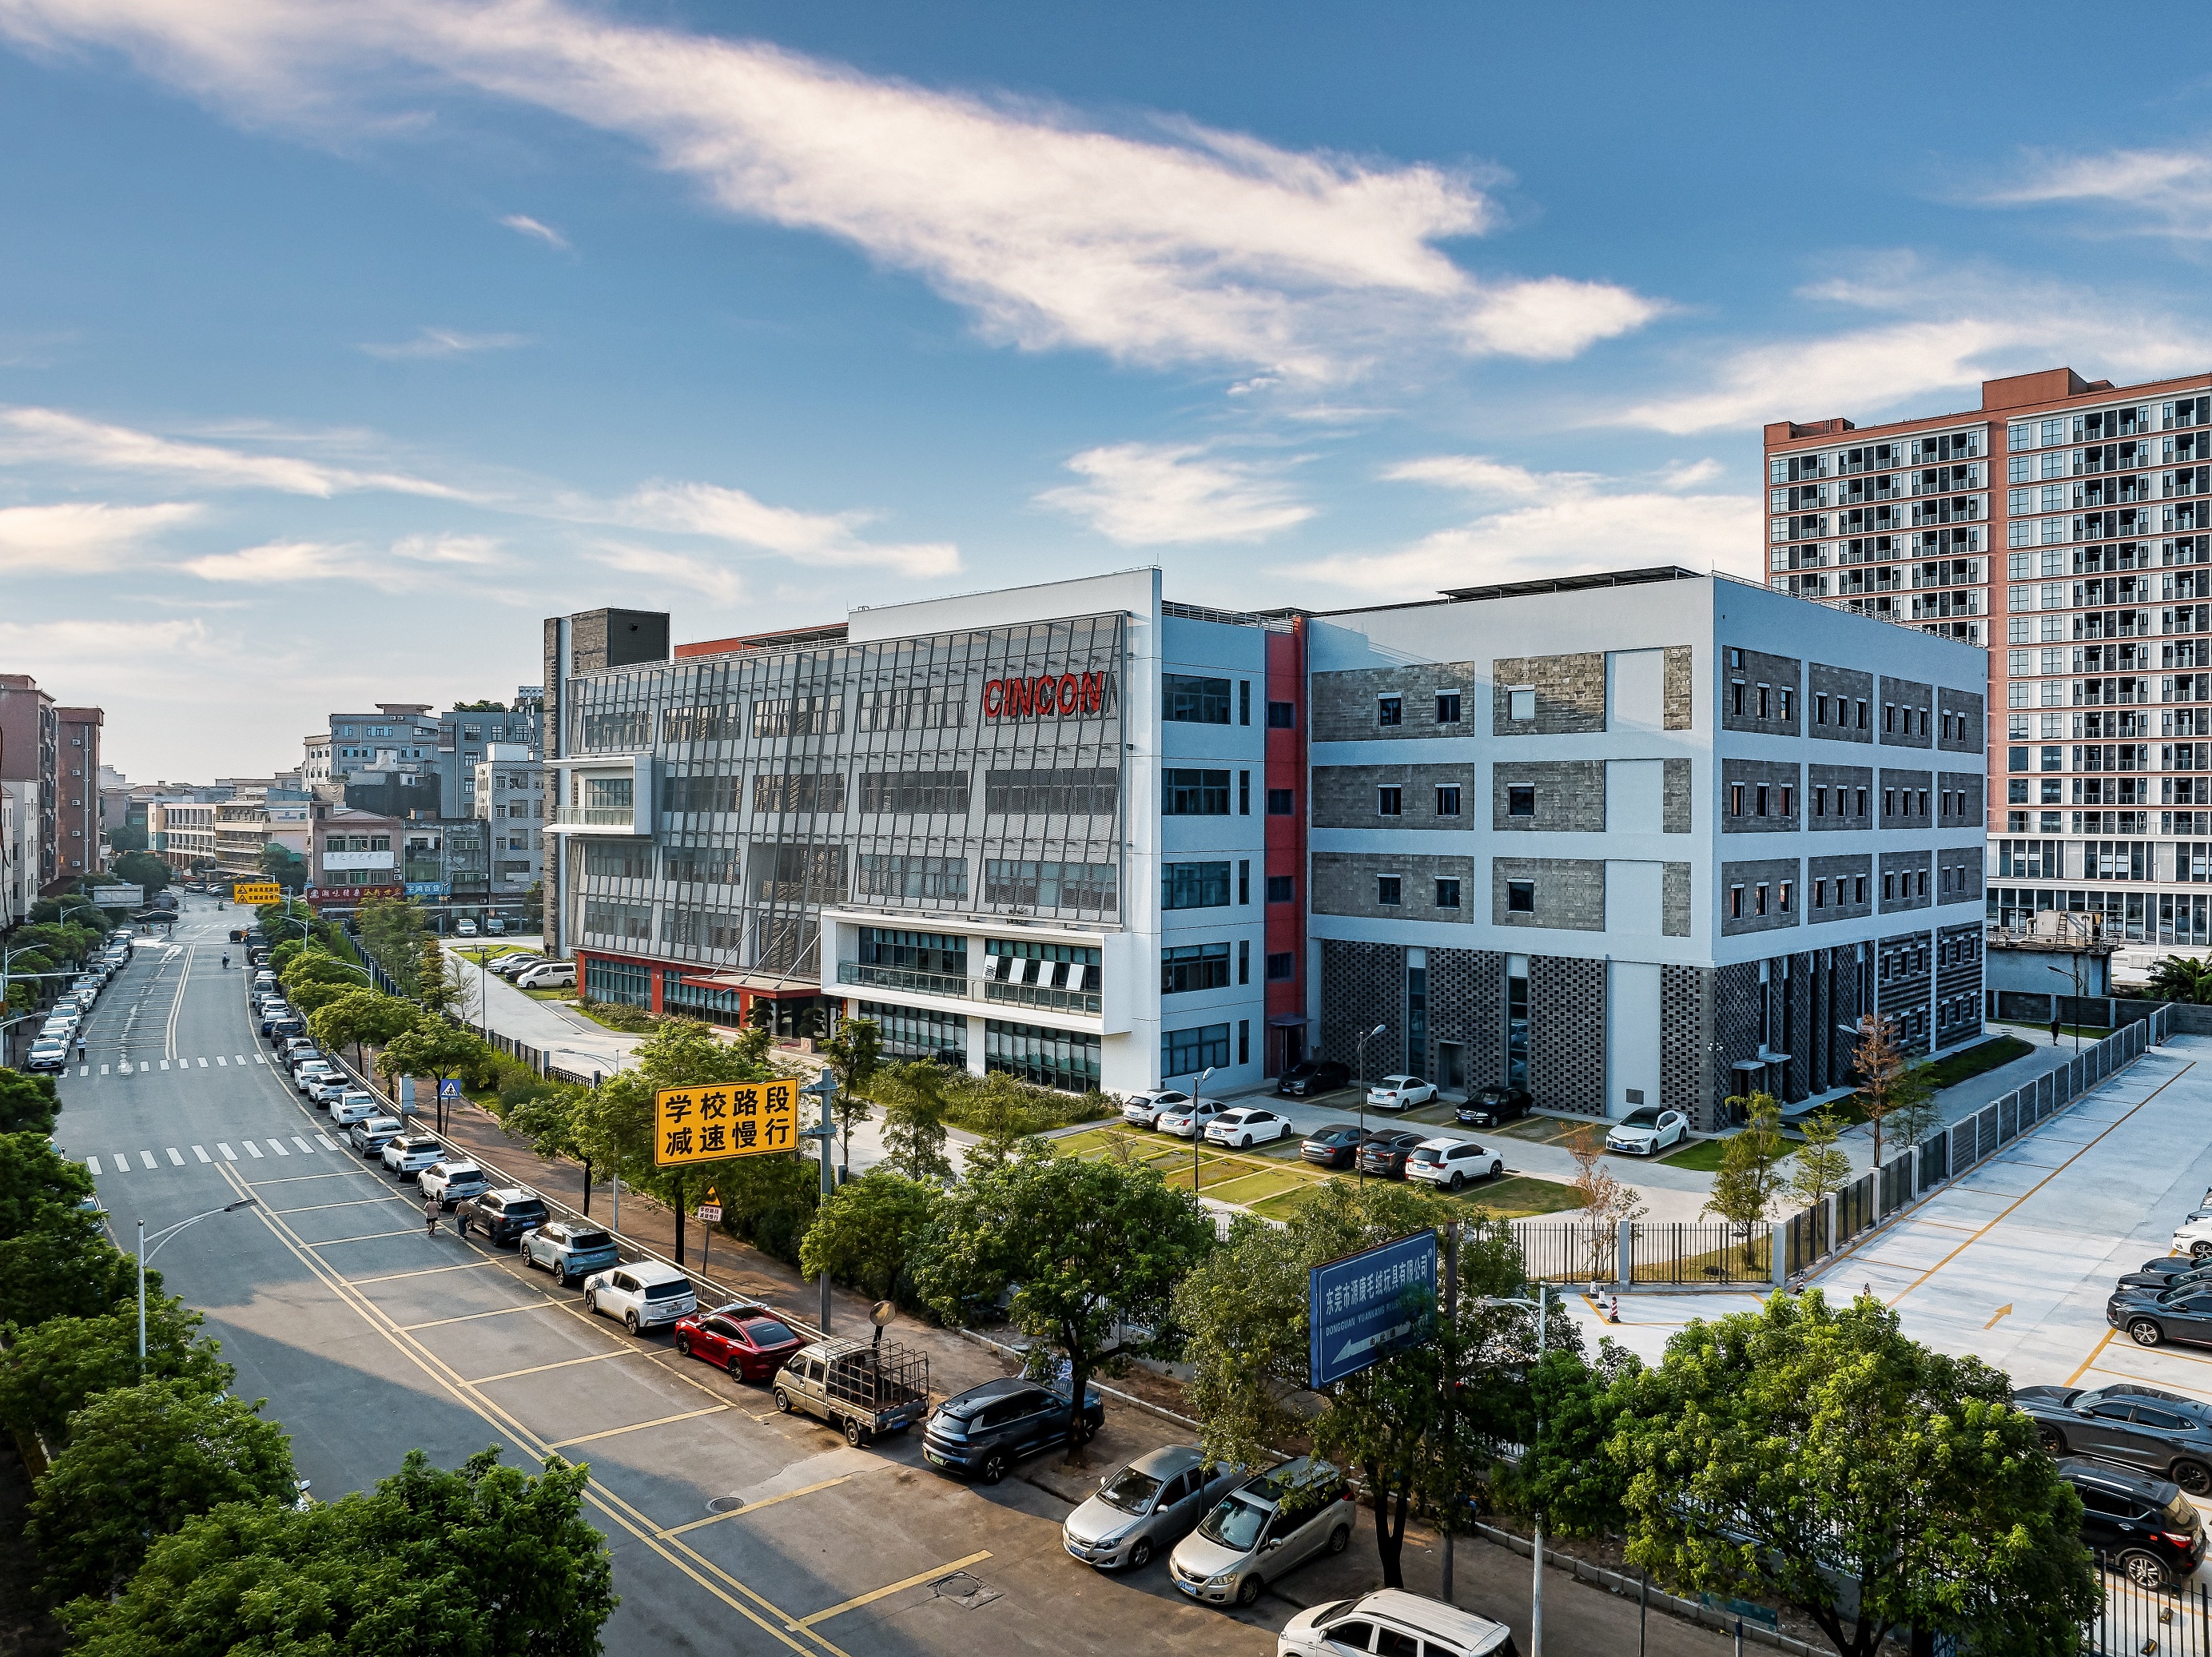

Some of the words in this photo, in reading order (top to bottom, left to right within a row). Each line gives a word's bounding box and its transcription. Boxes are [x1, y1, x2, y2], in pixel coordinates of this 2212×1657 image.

[984, 670, 1104, 718] CINCON
[665, 1085, 790, 1124] 学校路段
[665, 1117, 790, 1157] 减速慢行
[1326, 1254, 1428, 1316] 东莞市源康毛绒玩具有限公司
[1326, 1317, 1355, 1336] DONGGUAN
[1358, 1306, 1385, 1324] YUANKANG
